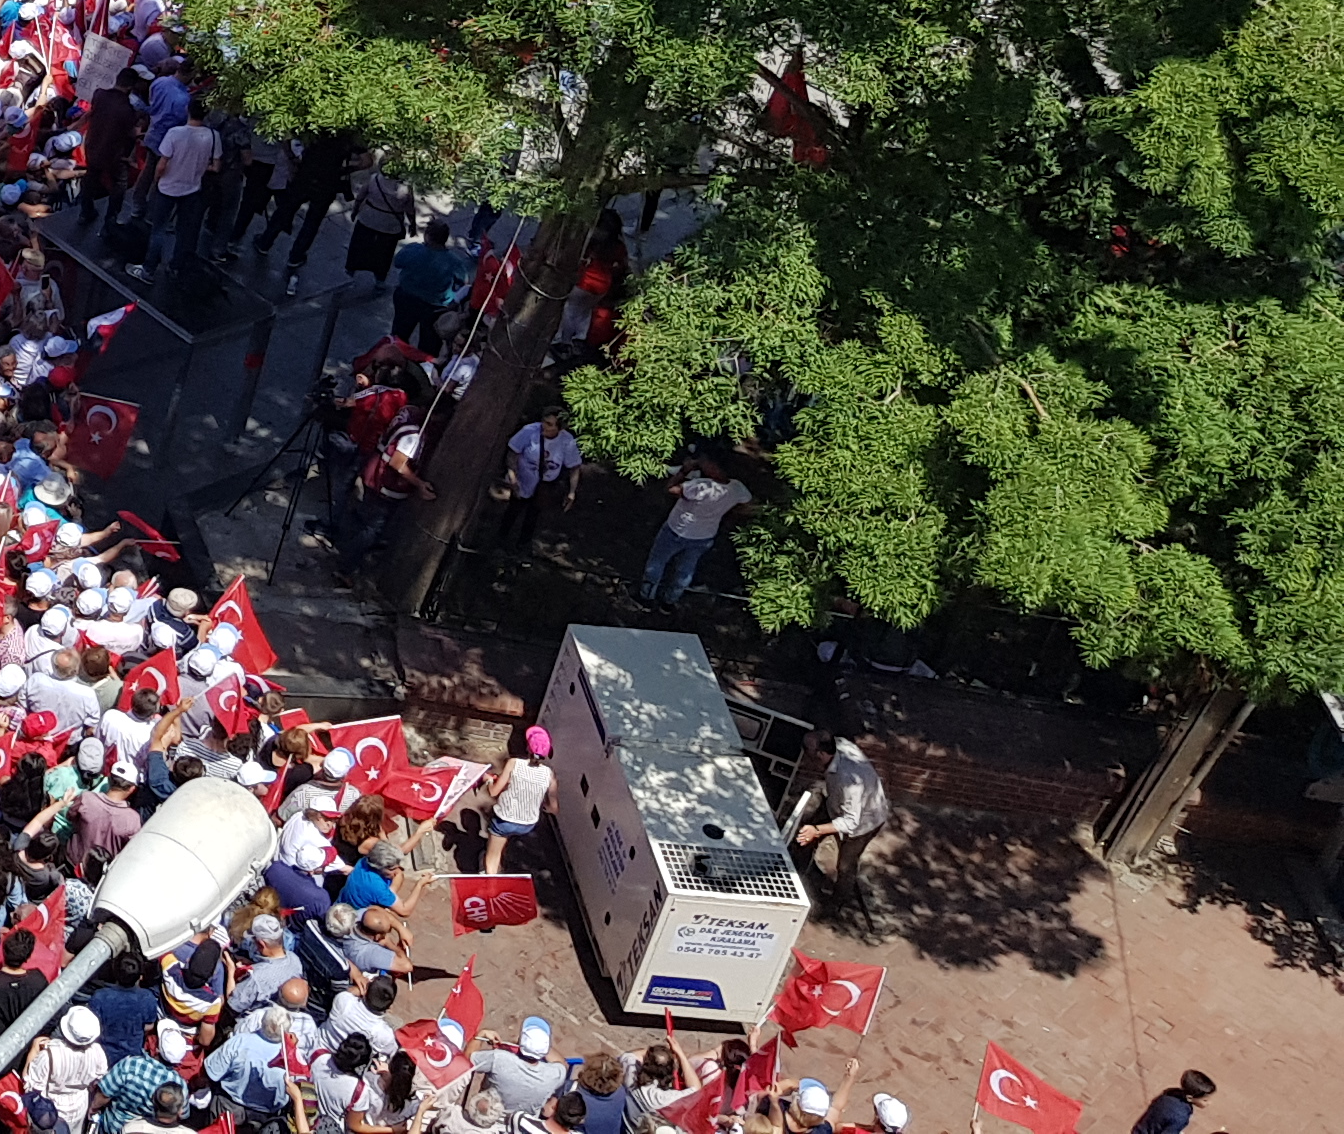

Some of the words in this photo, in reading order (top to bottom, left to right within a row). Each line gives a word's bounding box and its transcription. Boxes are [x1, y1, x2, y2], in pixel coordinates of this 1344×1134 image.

[463, 896, 488, 923] CHP
[627, 879, 664, 977] TEKSAN
[708, 917, 770, 930] TEKSAN
